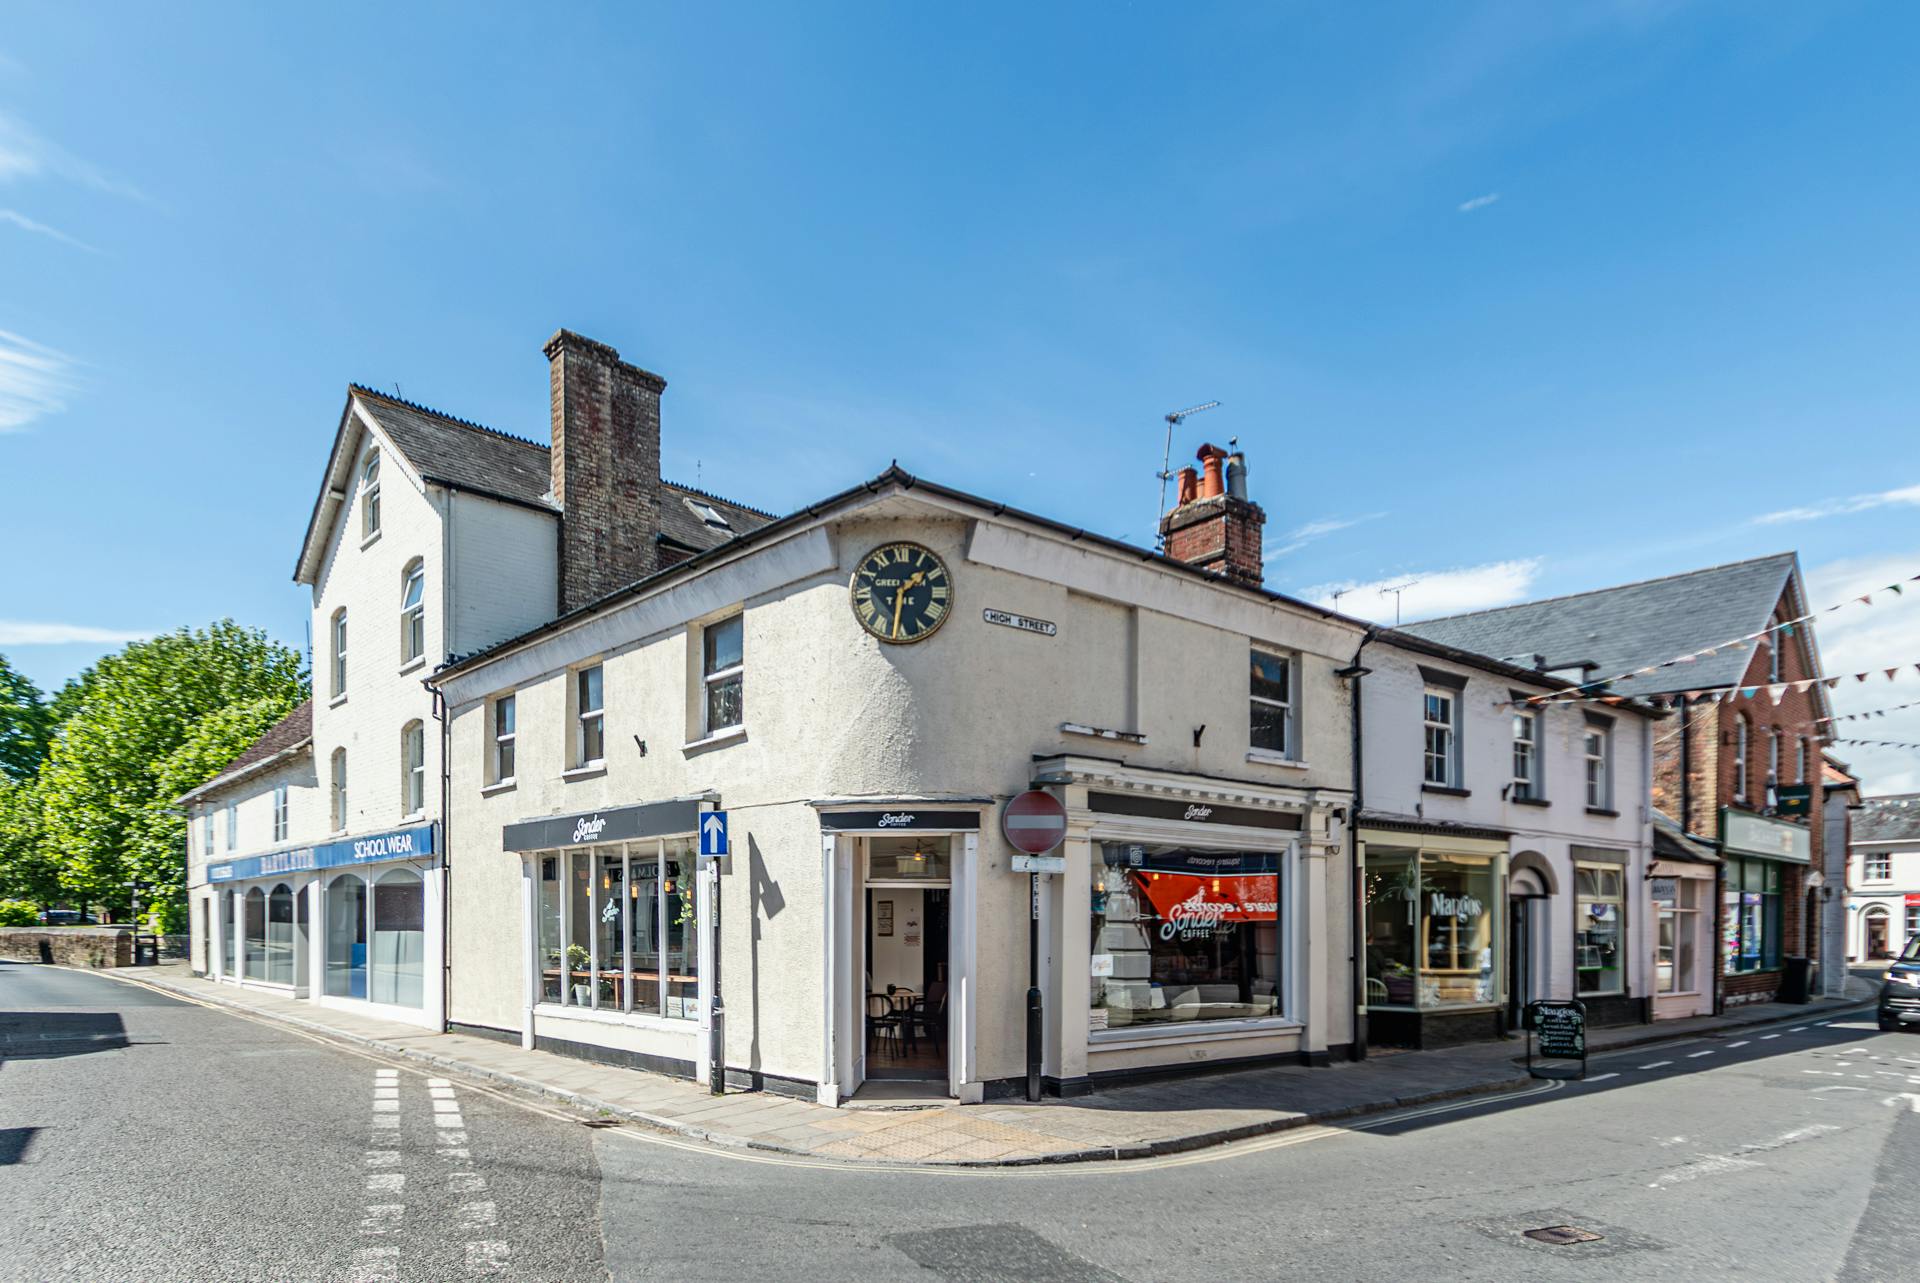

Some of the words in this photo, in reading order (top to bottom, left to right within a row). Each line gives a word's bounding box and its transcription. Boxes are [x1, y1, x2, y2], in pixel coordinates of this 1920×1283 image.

[990, 611, 1012, 625] HIGH
[1018, 618, 1050, 632] STREET
[878, 812, 915, 827] Sonder
[1184, 804, 1213, 820] Sonder
[573, 814, 606, 843] Sonder
[354, 838, 387, 858] SCHOOL
[387, 834, 413, 854] WEAR
[1161, 904, 1224, 940] Sonder
[1183, 929, 1210, 938] COFFEE
